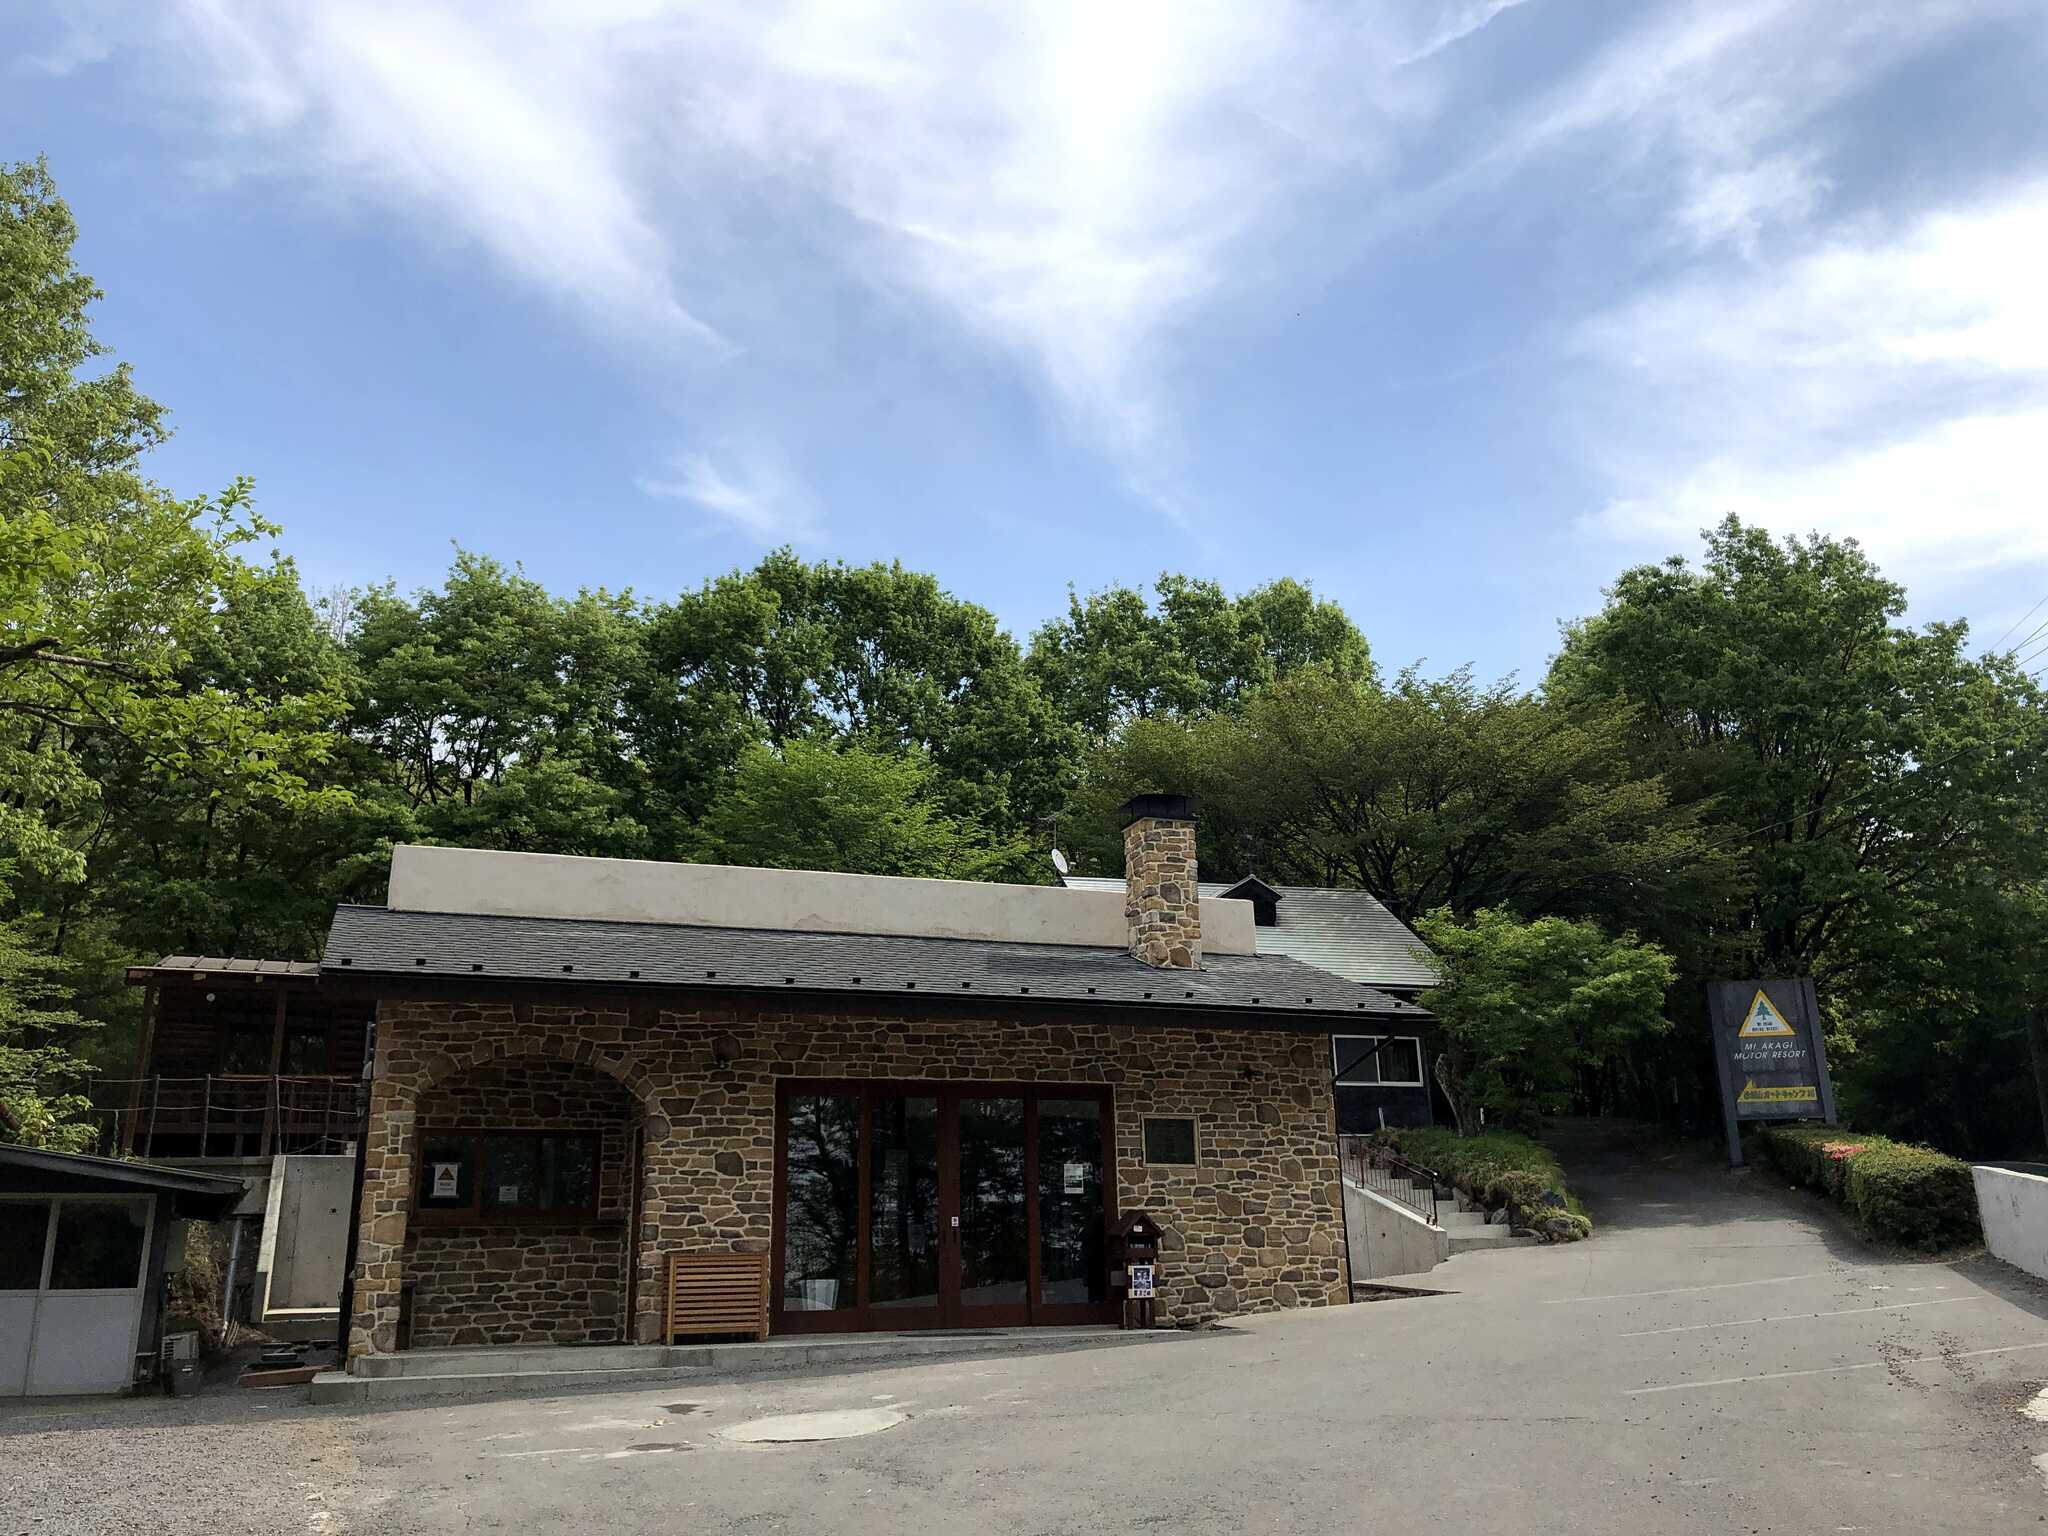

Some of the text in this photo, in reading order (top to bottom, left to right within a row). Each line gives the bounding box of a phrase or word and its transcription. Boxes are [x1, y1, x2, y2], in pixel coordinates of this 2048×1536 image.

[1744, 1041, 1793, 1051] MI AKAGI
[1734, 1049, 1806, 1060] MOTOR RESORT
